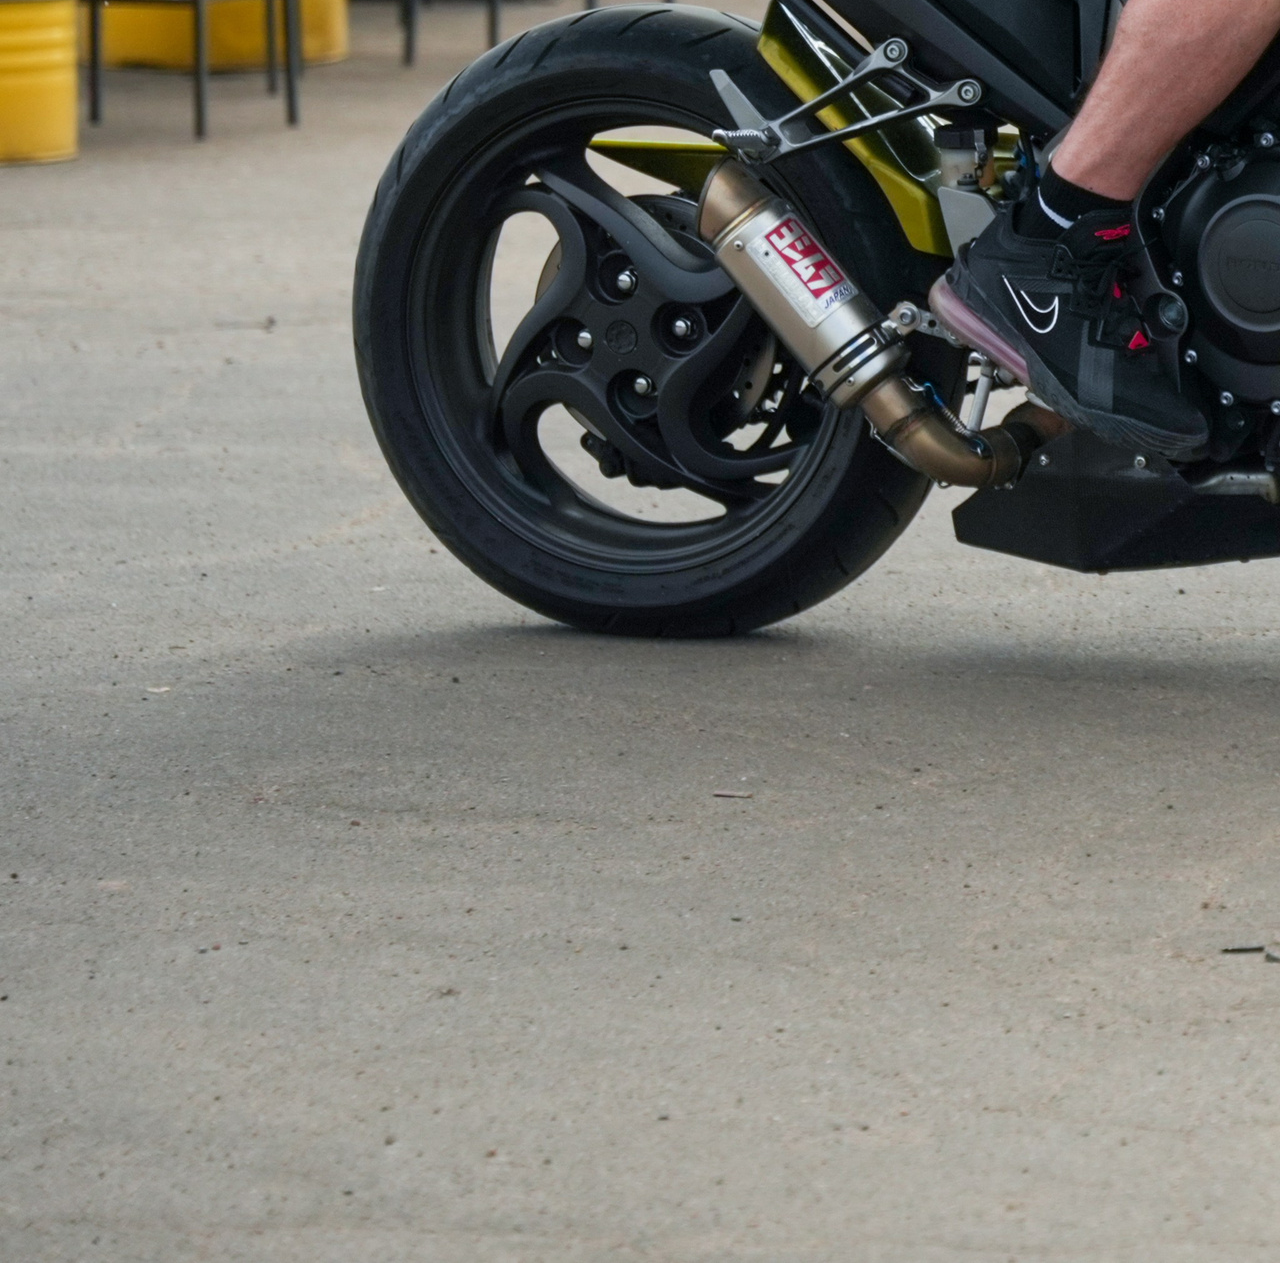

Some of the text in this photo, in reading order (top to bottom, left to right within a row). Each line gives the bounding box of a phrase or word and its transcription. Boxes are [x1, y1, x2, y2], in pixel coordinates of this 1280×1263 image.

[769, 220, 841, 291] ヨシムラ
[824, 285, 851, 309] JAPAN
